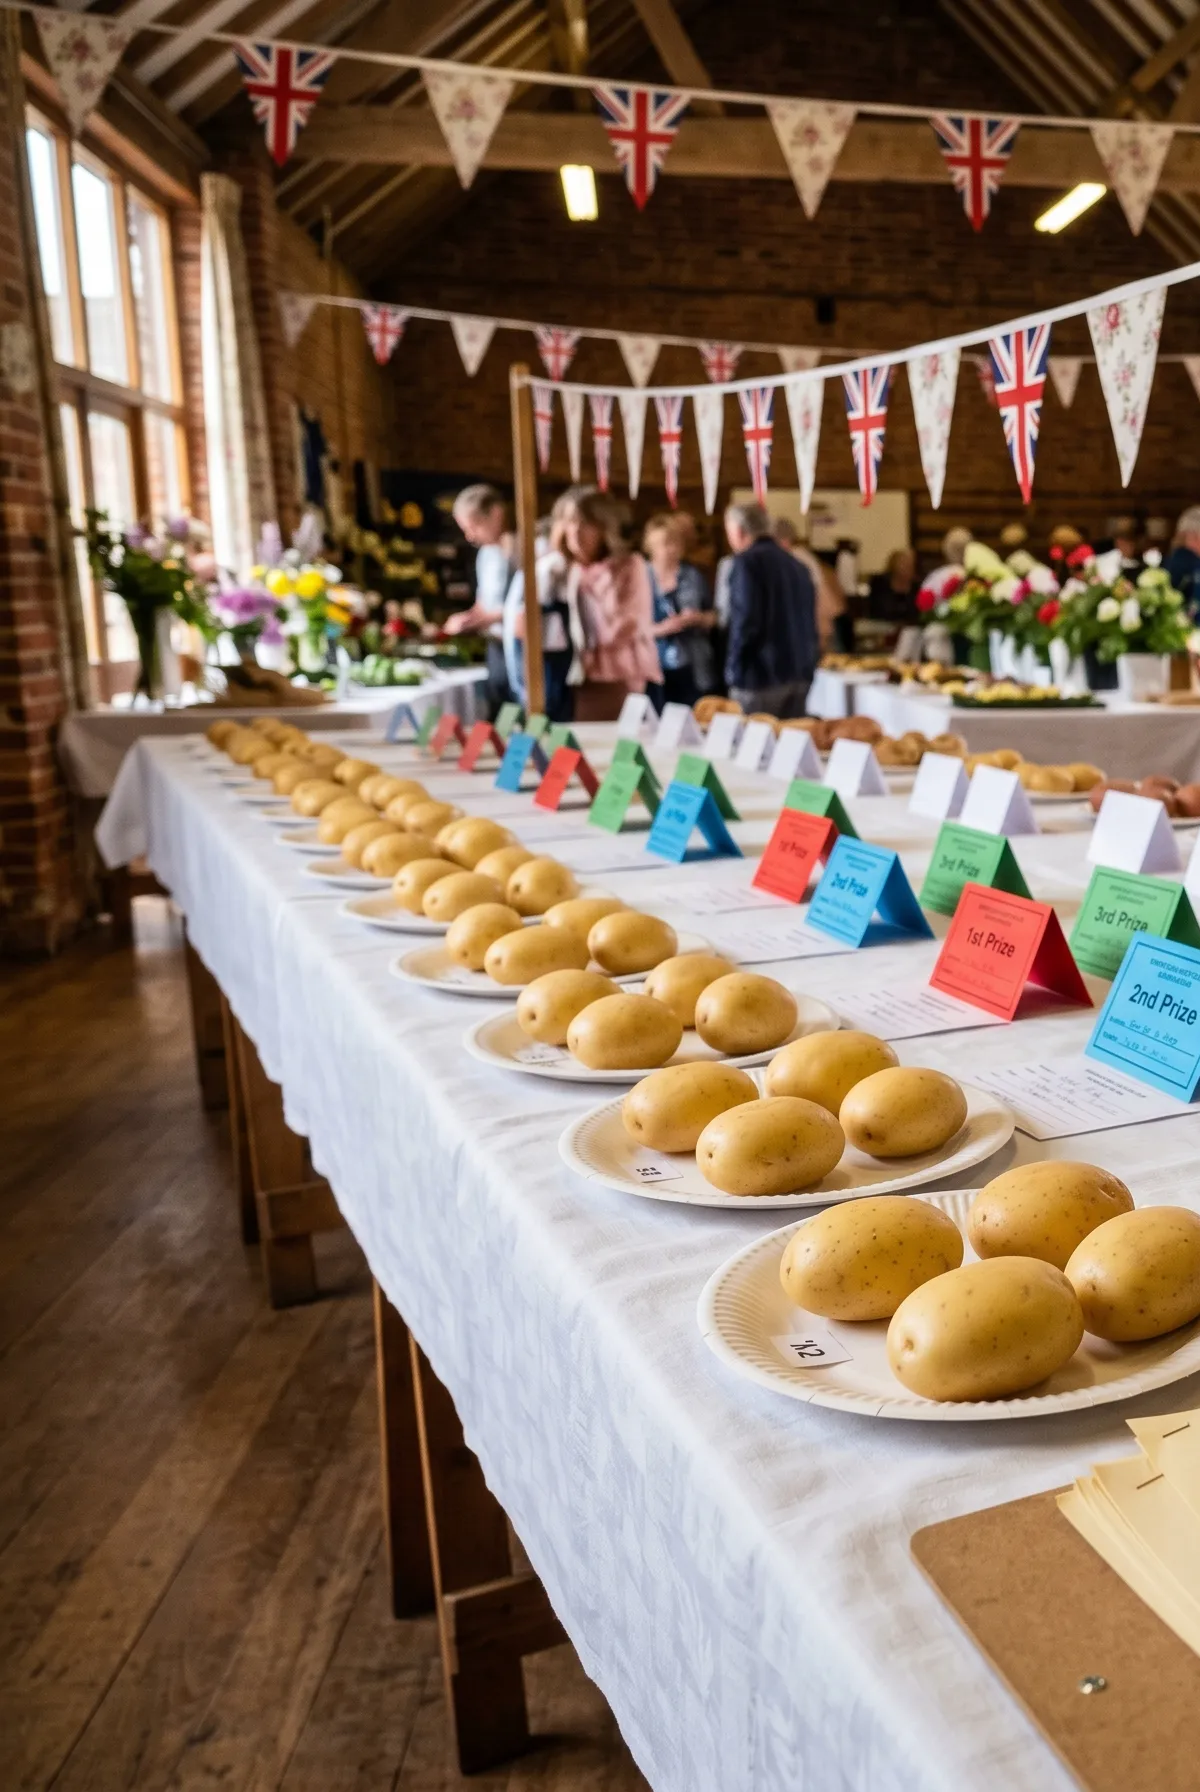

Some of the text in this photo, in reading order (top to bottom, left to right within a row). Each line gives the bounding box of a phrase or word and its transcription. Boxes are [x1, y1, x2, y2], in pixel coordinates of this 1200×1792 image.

[1094, 906, 1148, 932] 3rd Prize
[967, 927, 1016, 958] 1st Prize
[1128, 984, 1198, 1026] 2nd Prize
